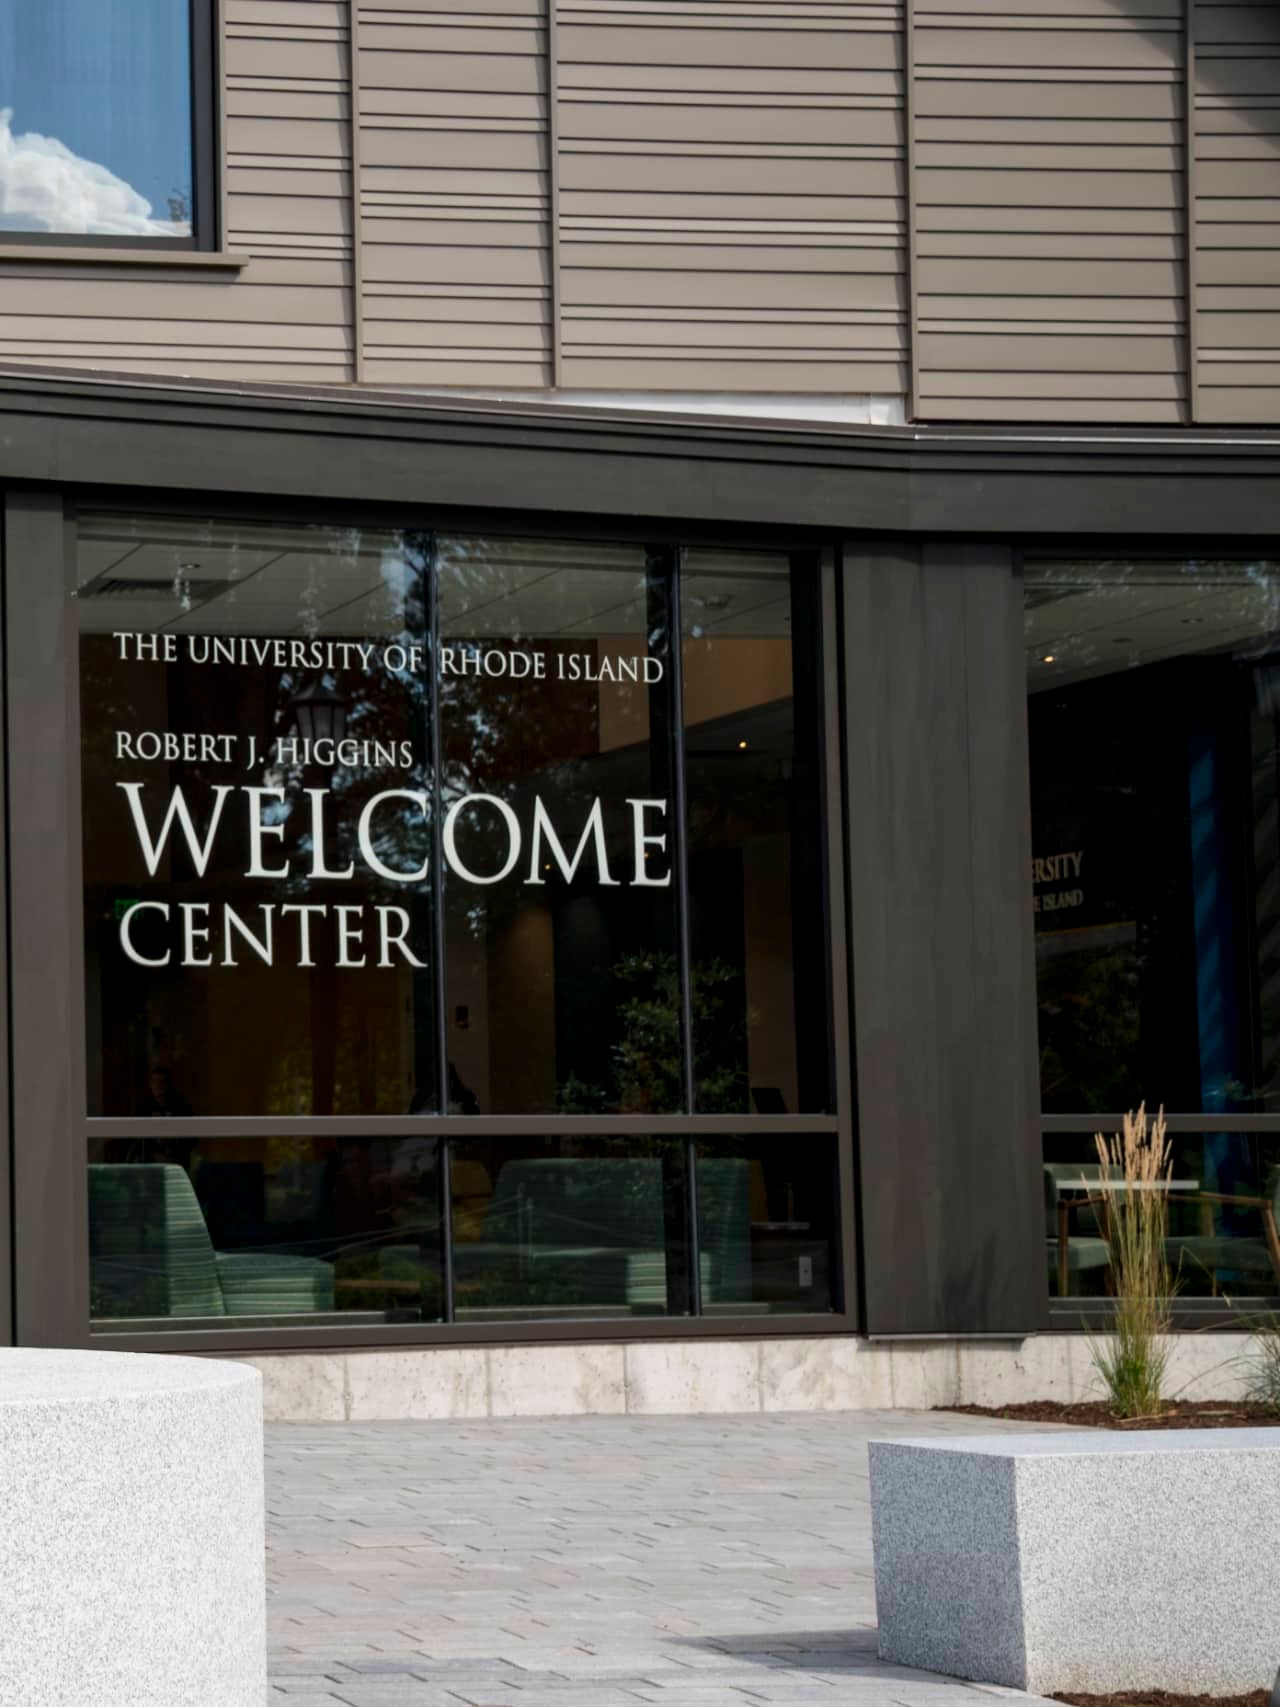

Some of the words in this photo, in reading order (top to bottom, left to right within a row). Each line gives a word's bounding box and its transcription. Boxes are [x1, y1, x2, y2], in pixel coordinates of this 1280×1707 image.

[113, 632, 177, 662] THE
[189, 637, 374, 671] UNIVERSITY
[383, 645, 423, 674] OF
[440, 648, 547, 679] RHODE
[558, 654, 664, 684] ISLAND
[116, 731, 238, 763] ROBERT
[247, 736, 265, 771] J.
[276, 738, 413, 769] HIGGINS
[116, 782, 672, 888] WELCOME
[120, 901, 429, 968] CENTER
